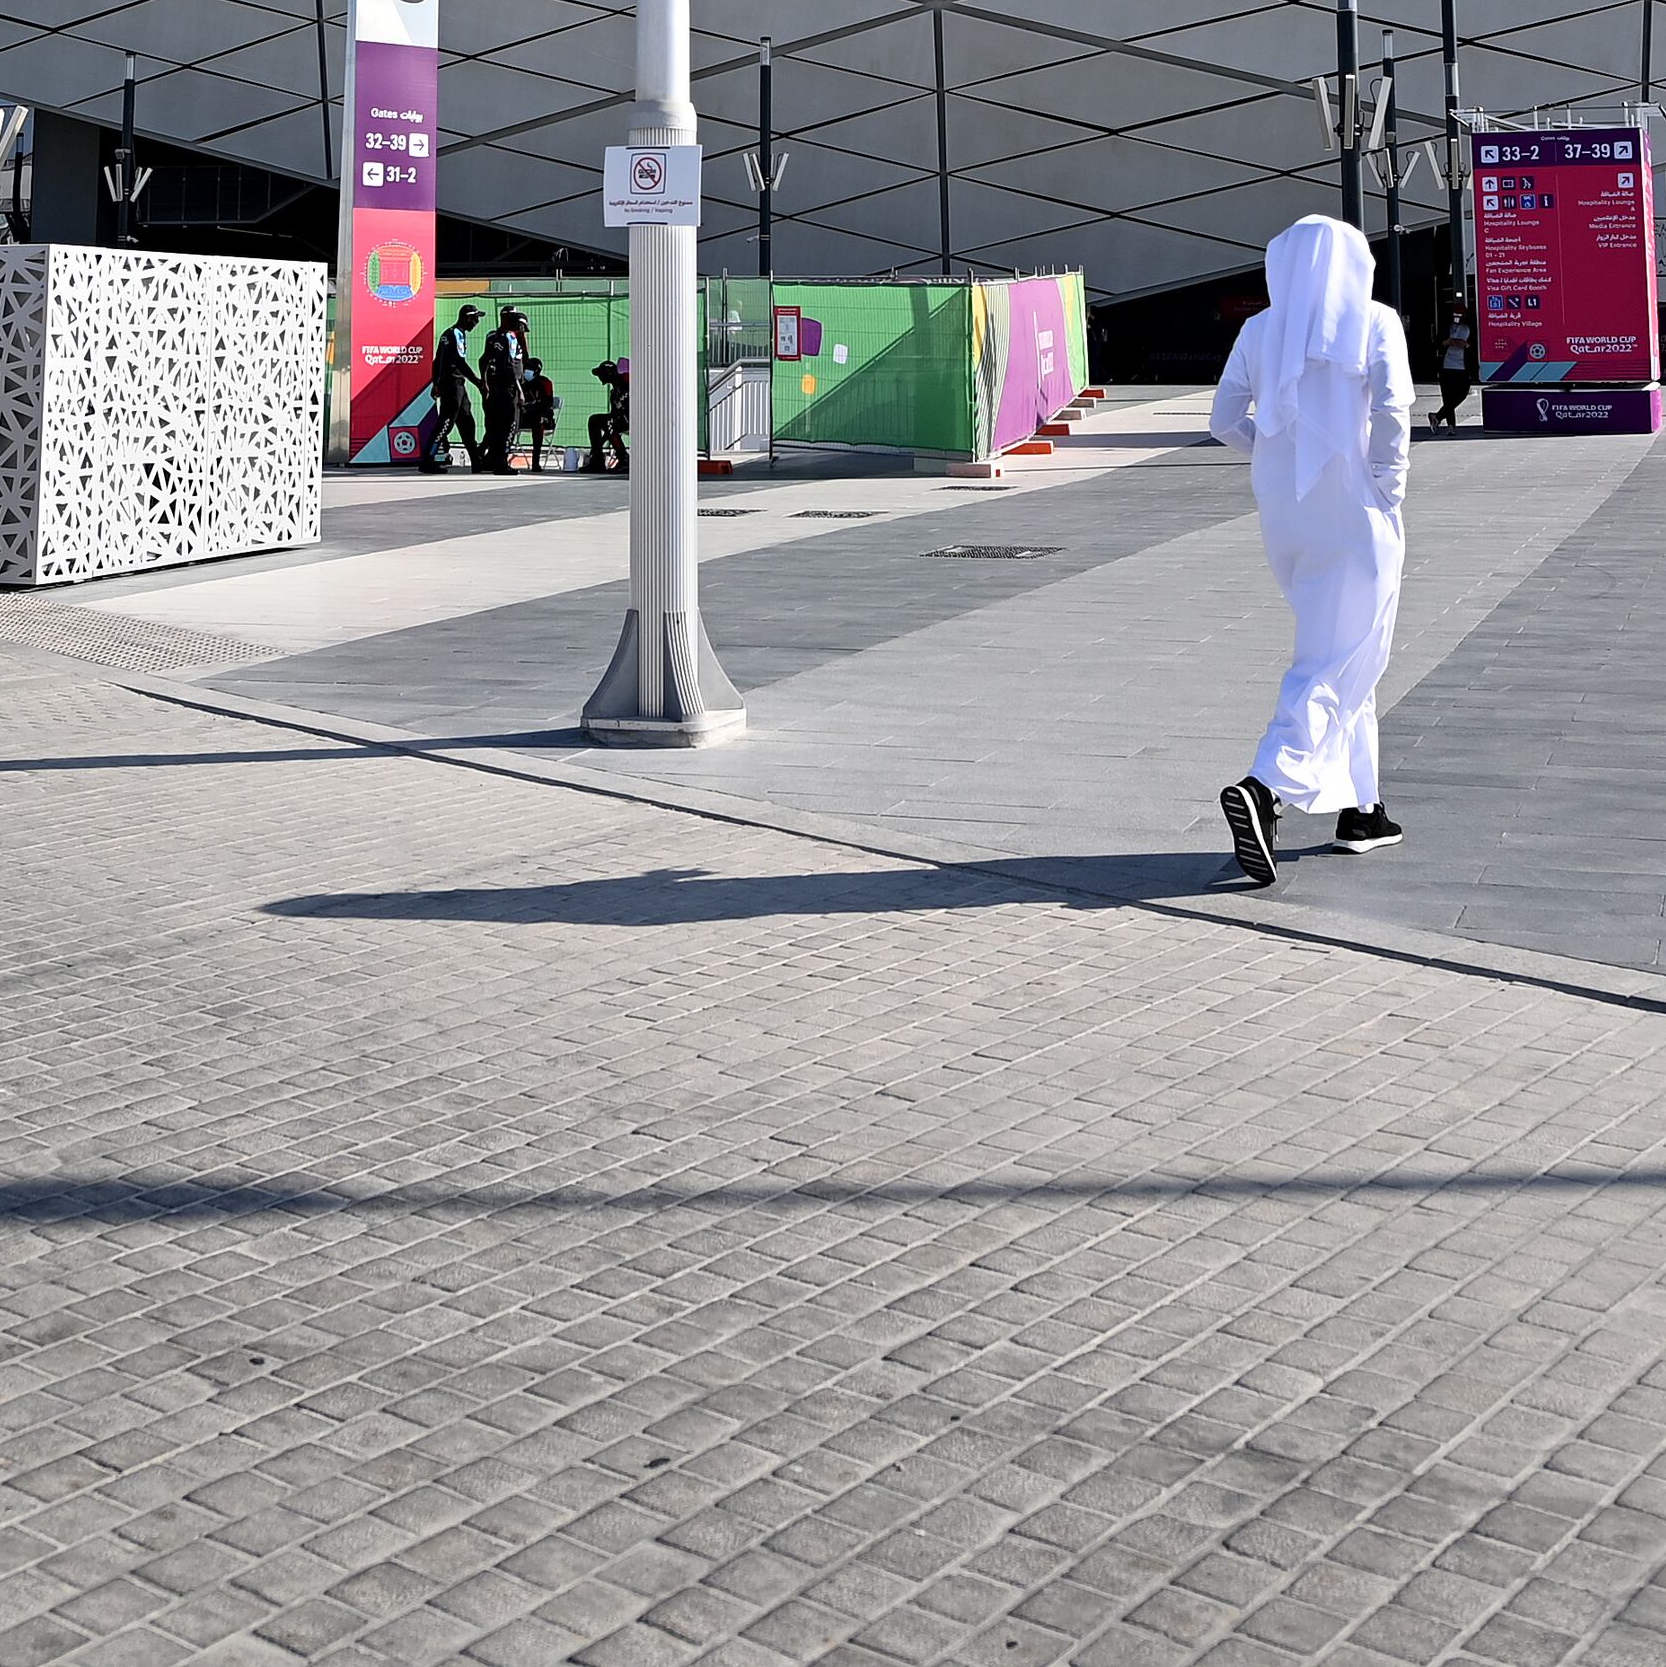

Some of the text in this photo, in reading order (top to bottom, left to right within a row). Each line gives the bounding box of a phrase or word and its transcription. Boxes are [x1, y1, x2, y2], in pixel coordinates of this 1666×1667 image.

[370, 107, 399, 119] Gates
[1566, 336, 1637, 344] FIFA WORLD CUP
[361, 345, 423, 354] FIFA WORLD CUP
